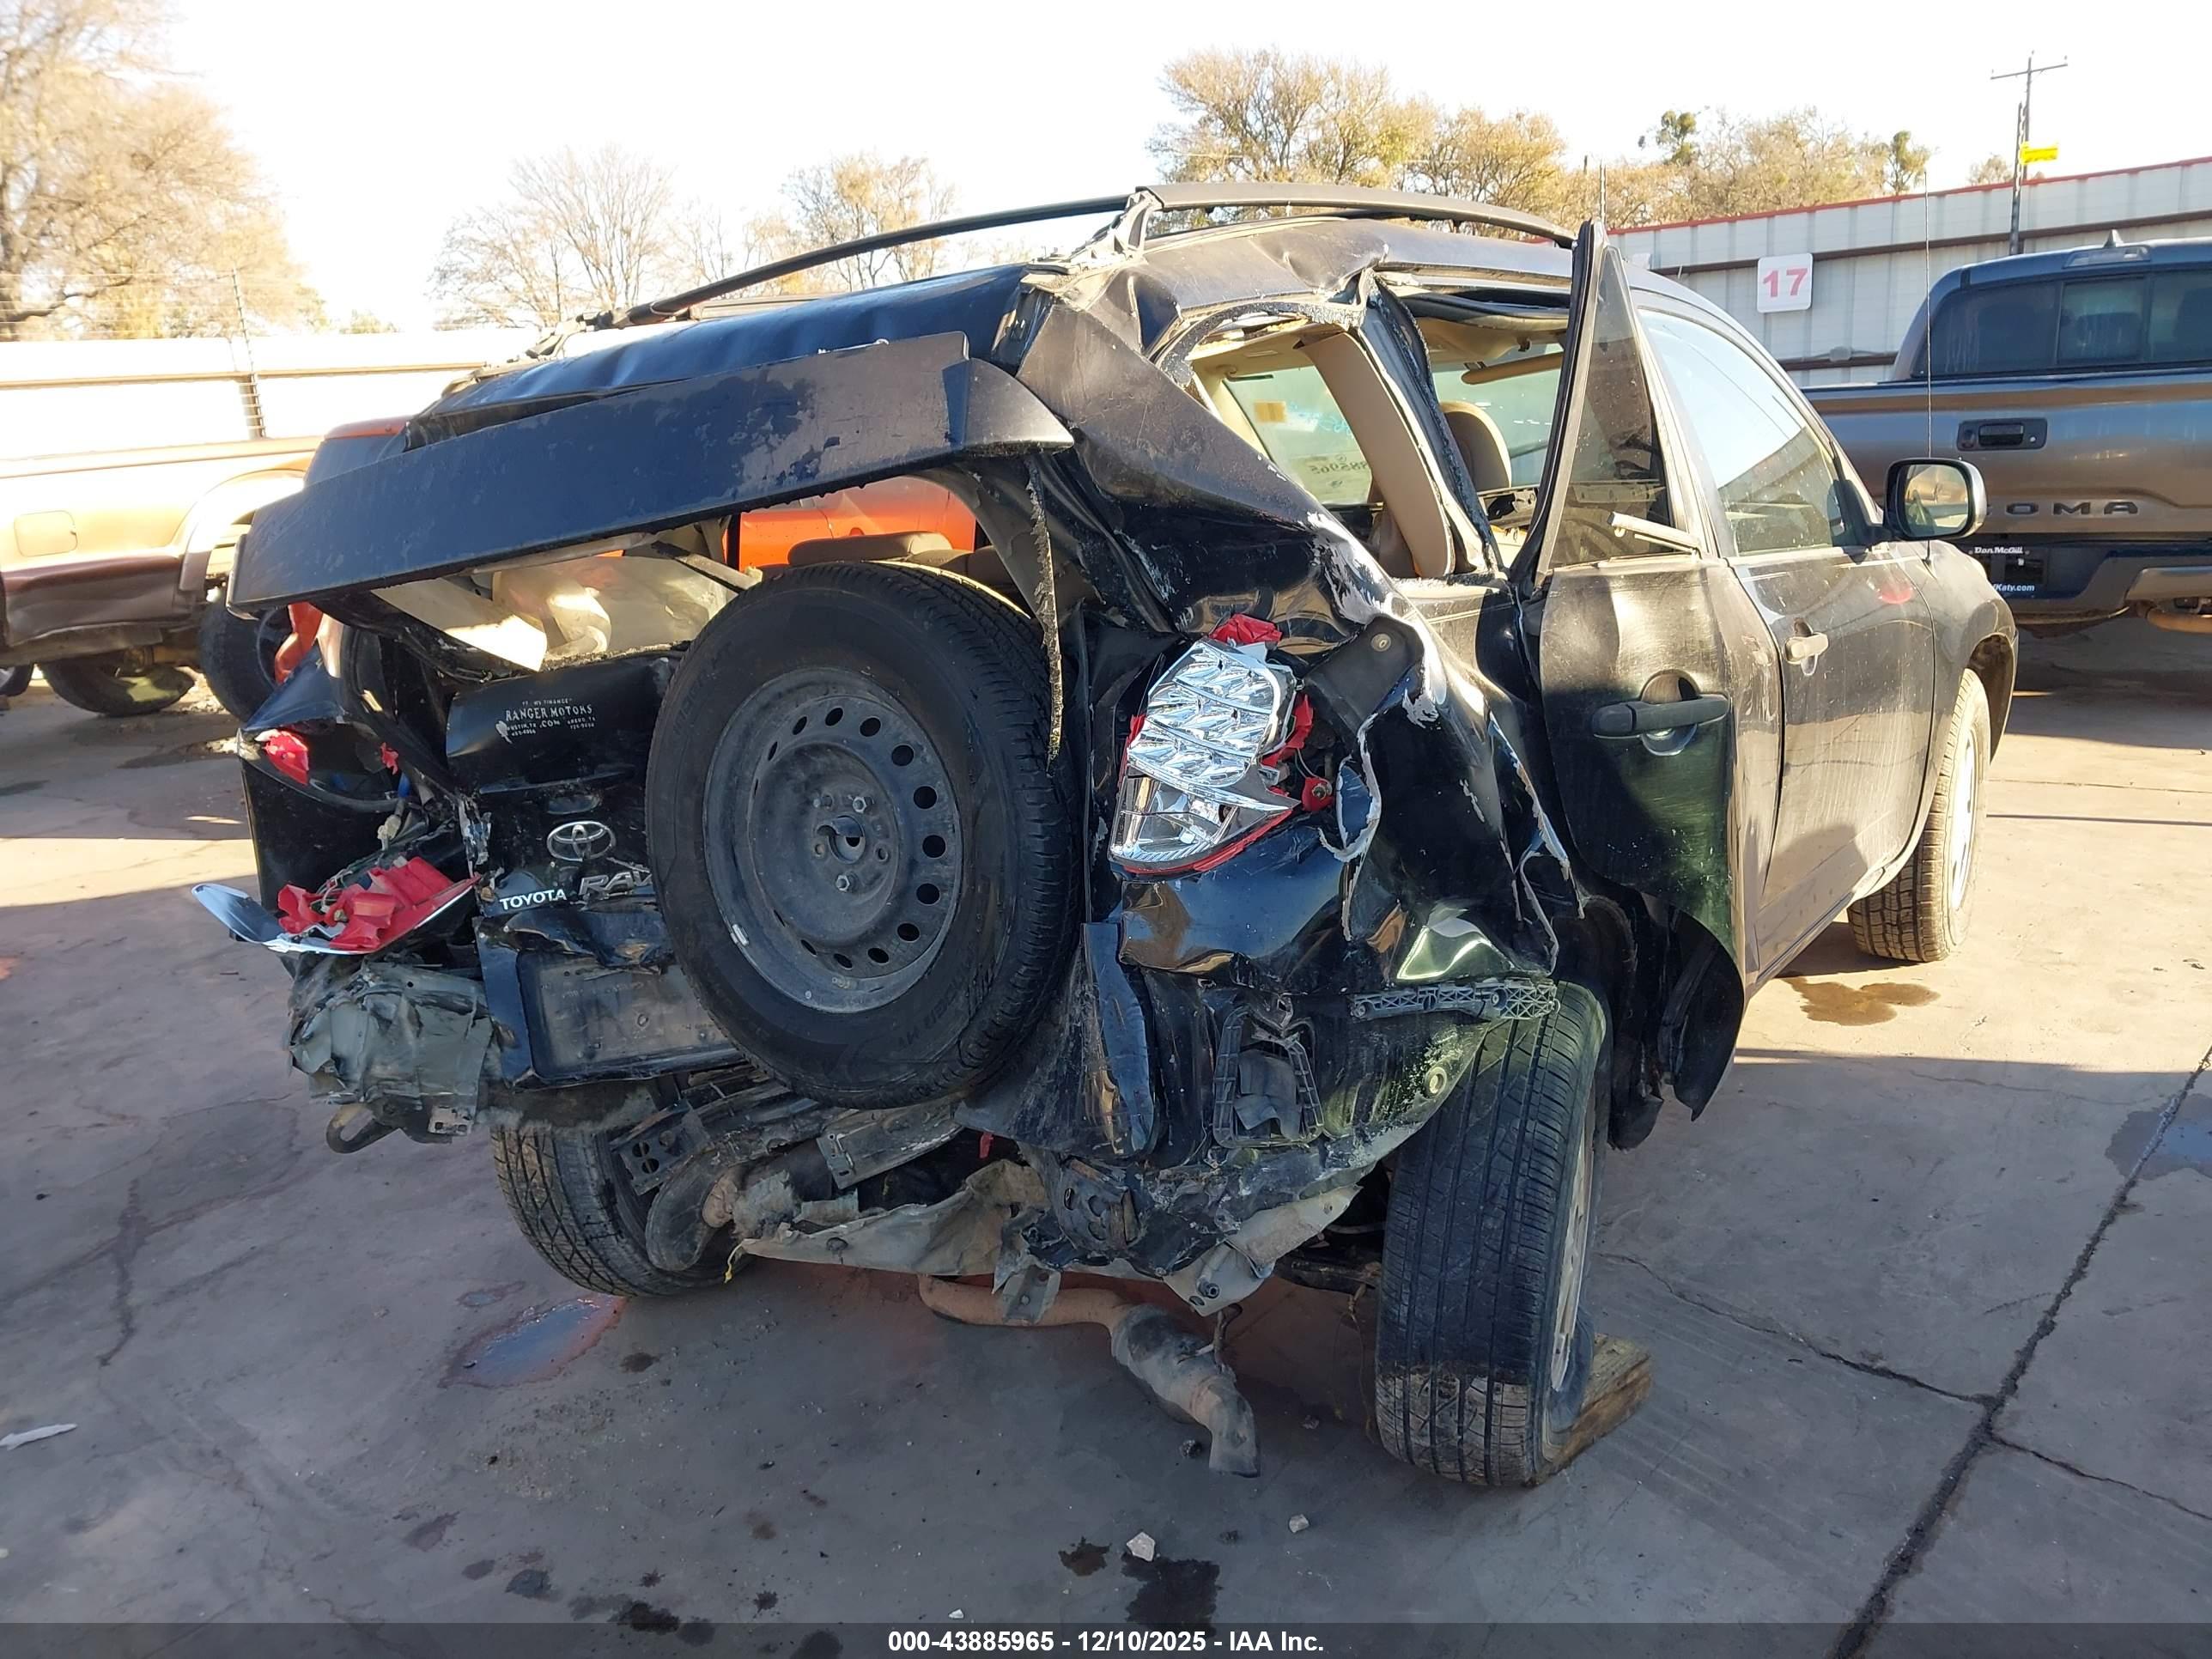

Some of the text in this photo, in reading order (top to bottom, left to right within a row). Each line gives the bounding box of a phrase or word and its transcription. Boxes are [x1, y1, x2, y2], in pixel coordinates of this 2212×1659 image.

[1763, 268, 1808, 297] 17
[1987, 501, 2138, 515] OMA
[505, 707, 548, 722] RANGER
[578, 870, 653, 900] RAV
[499, 888, 567, 910] TOYOTA
